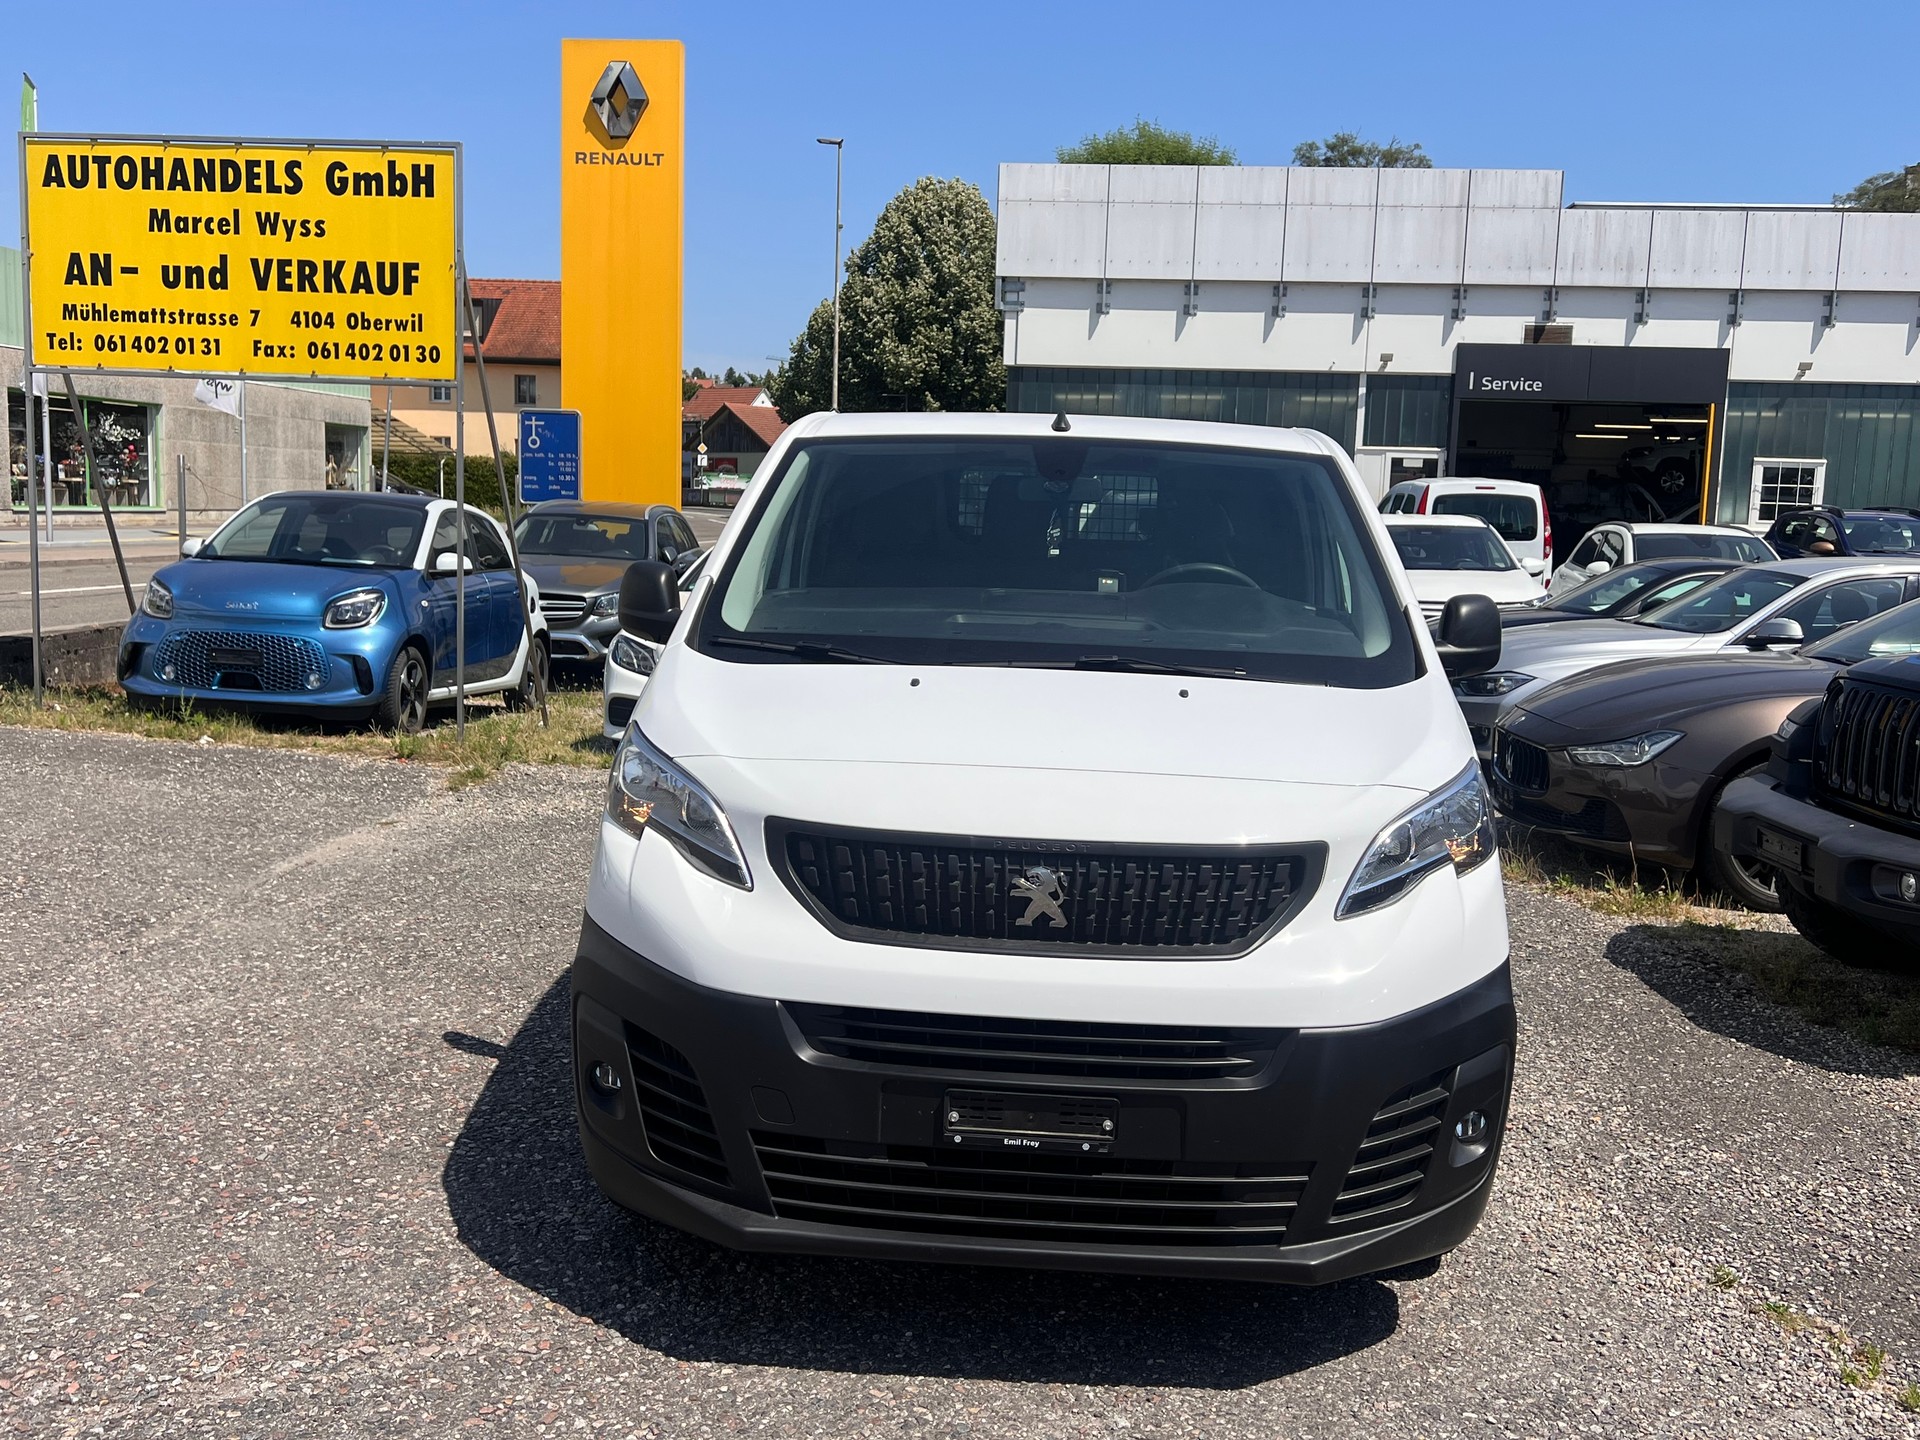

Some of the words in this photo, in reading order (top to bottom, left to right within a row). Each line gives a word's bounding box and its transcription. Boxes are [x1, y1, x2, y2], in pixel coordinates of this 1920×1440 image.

[575, 151, 665, 166] RENAULT
[42, 154, 303, 195] AUTOHANDELS
[325, 160, 435, 198] GmbH
[148, 208, 240, 236] Marcel
[255, 211, 326, 243] Wyss
[161, 254, 229, 291] und
[250, 257, 420, 296] VERKAUF
[62, 303, 239, 327] Mühlemattstrasse
[249, 309, 261, 328] 7
[290, 311, 335, 330] 4104
[346, 312, 423, 333] Oberwil
[46, 333, 82, 352] Tel:
[253, 340, 295, 359] Fax:
[1481, 376, 1543, 392] Service
[993, 839, 1091, 853] PEUGEOT
[1003, 1138, 1021, 1147] Emil
[1023, 1139, 1040, 1148] Frey
